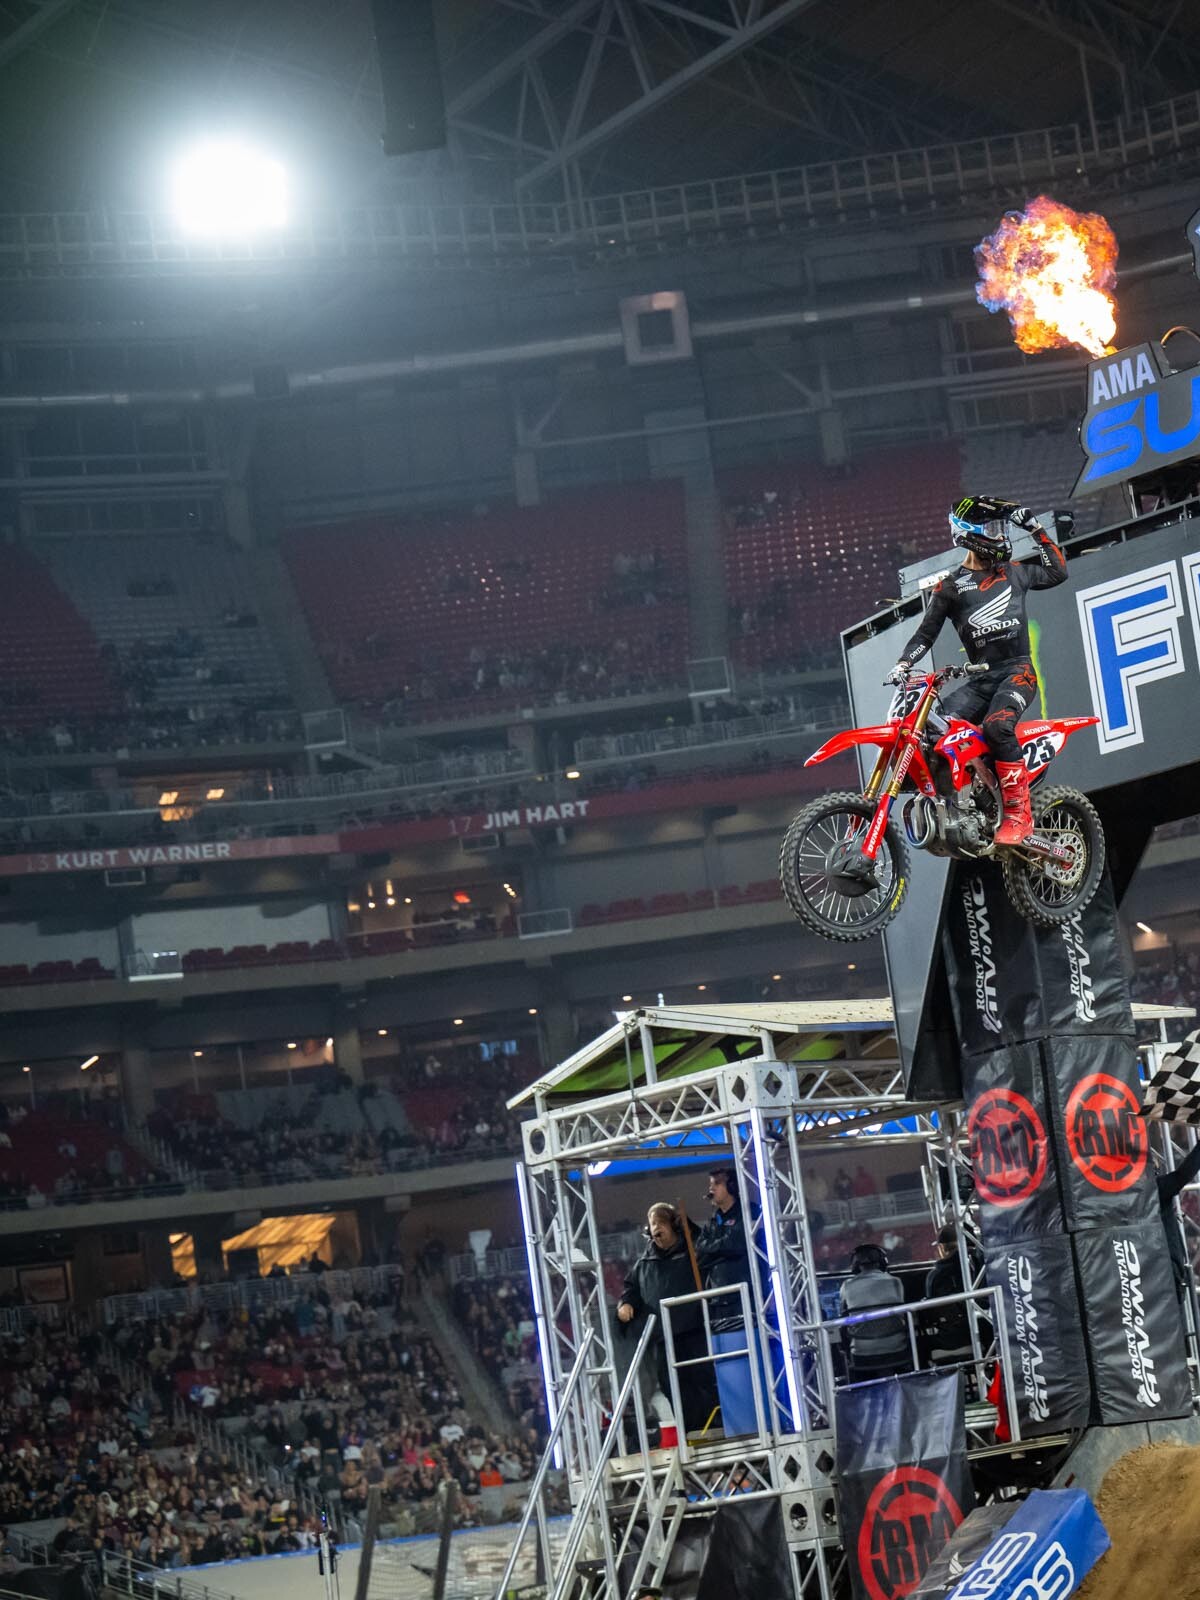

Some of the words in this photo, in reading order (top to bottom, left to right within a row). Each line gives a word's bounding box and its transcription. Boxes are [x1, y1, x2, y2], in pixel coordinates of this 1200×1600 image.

[1091, 352, 1155, 405] AMA
[971, 617, 1021, 638] HONDA
[909, 644, 926, 660] ONDA
[943, 729, 975, 746] CRF
[1023, 725, 1052, 736] HONDA
[897, 745, 915, 782] SHOWA
[1021, 735, 1056, 771] 23
[482, 809, 520, 830] JIM
[525, 800, 590, 824] HART
[868, 809, 885, 853] DUNLOP
[56, 850, 119, 869] KURT
[128, 842, 231, 864] WARNER
[974, 961, 985, 1011] ROCKY
[1066, 945, 1081, 998] ROCKY
[1007, 1257, 1029, 1344] MOUNTAIN
[1112, 1239, 1133, 1328] MOUNTAIN
[1021, 1346, 1035, 1399] ROCKY
[1124, 1328, 1143, 1382] ROCKY
